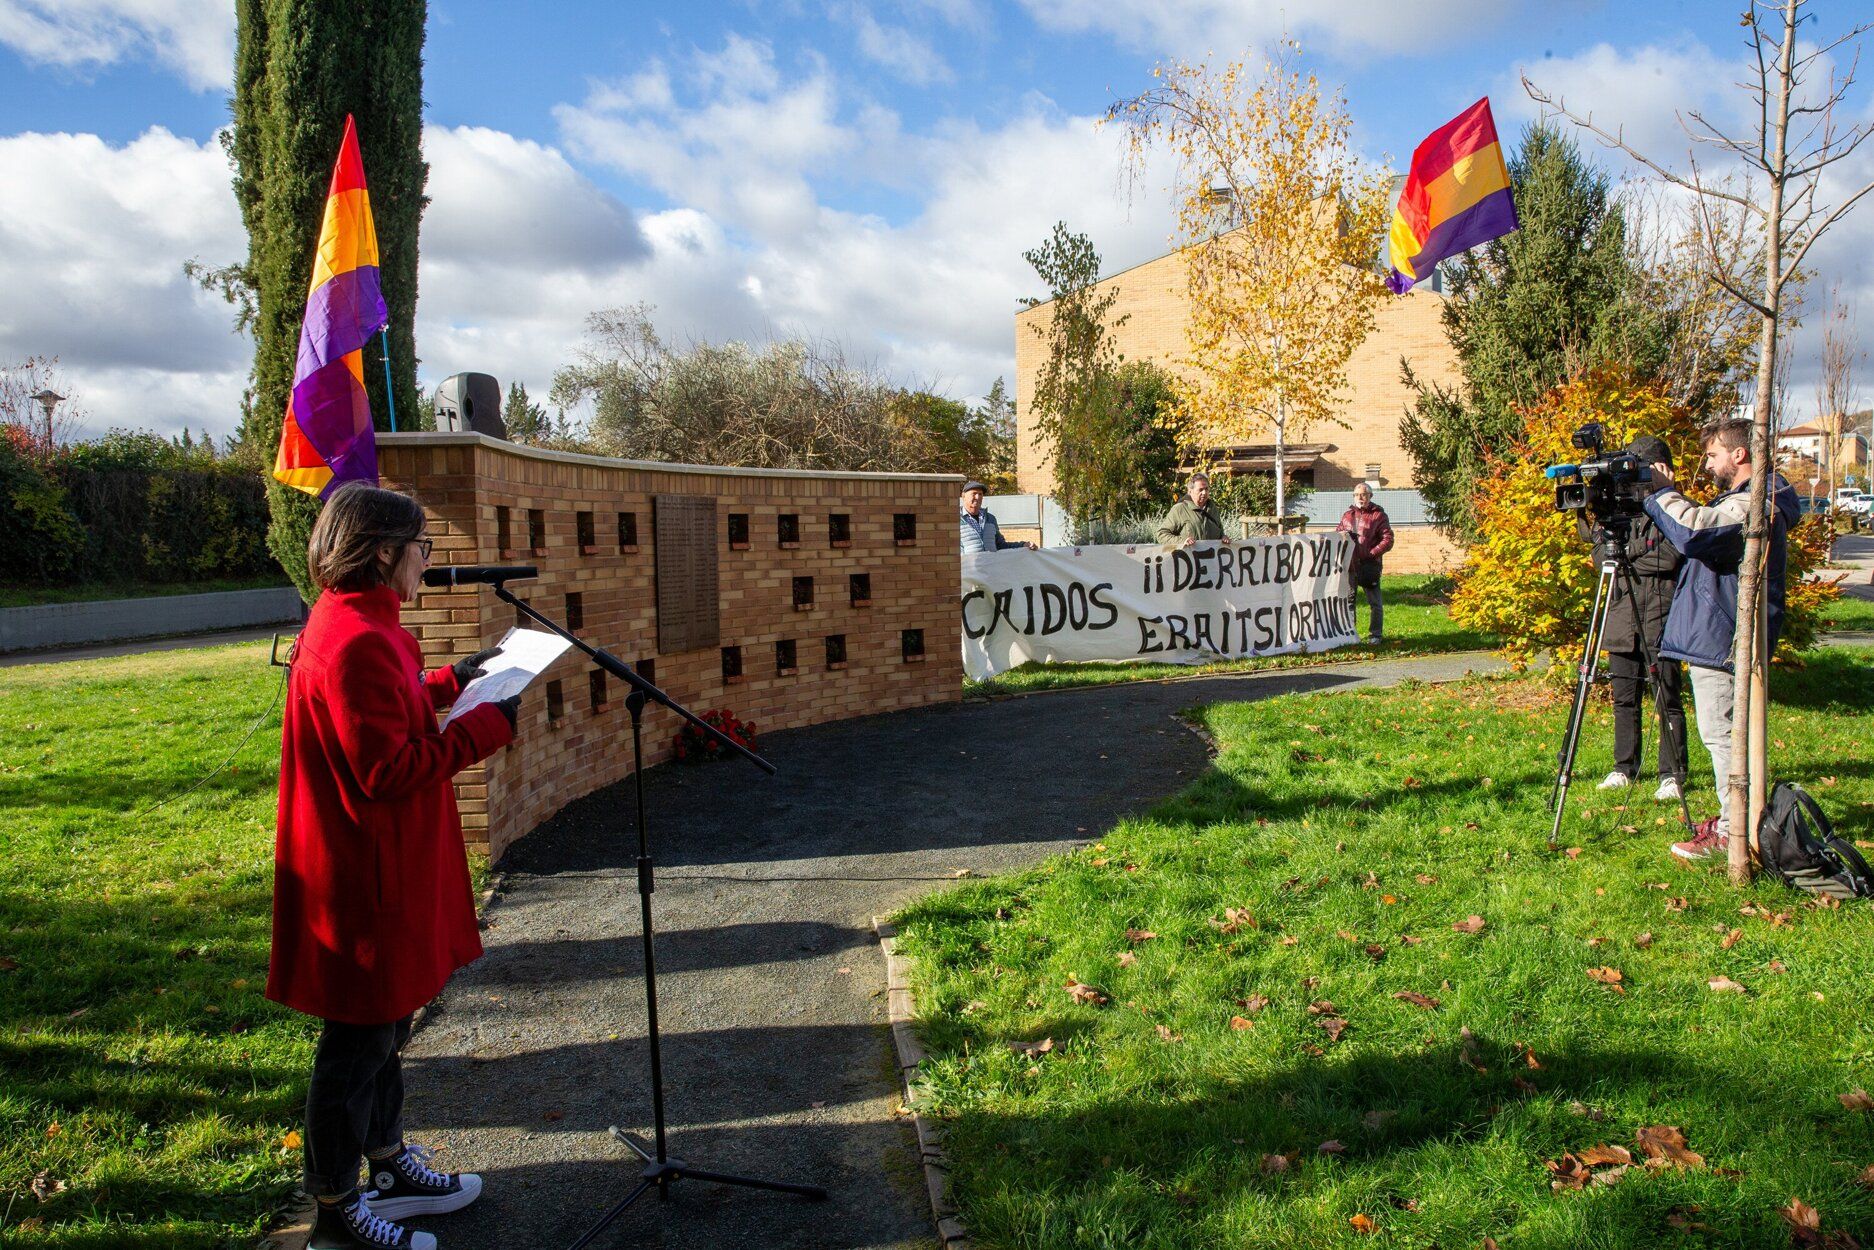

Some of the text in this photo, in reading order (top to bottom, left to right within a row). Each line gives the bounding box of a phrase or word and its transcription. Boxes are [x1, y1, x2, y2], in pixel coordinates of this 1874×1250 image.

[1308, 539, 1348, 577] YA!!
[961, 582, 1118, 639] CAIDOS
[1137, 596, 1355, 654] ERAITSI ORAIN!!
